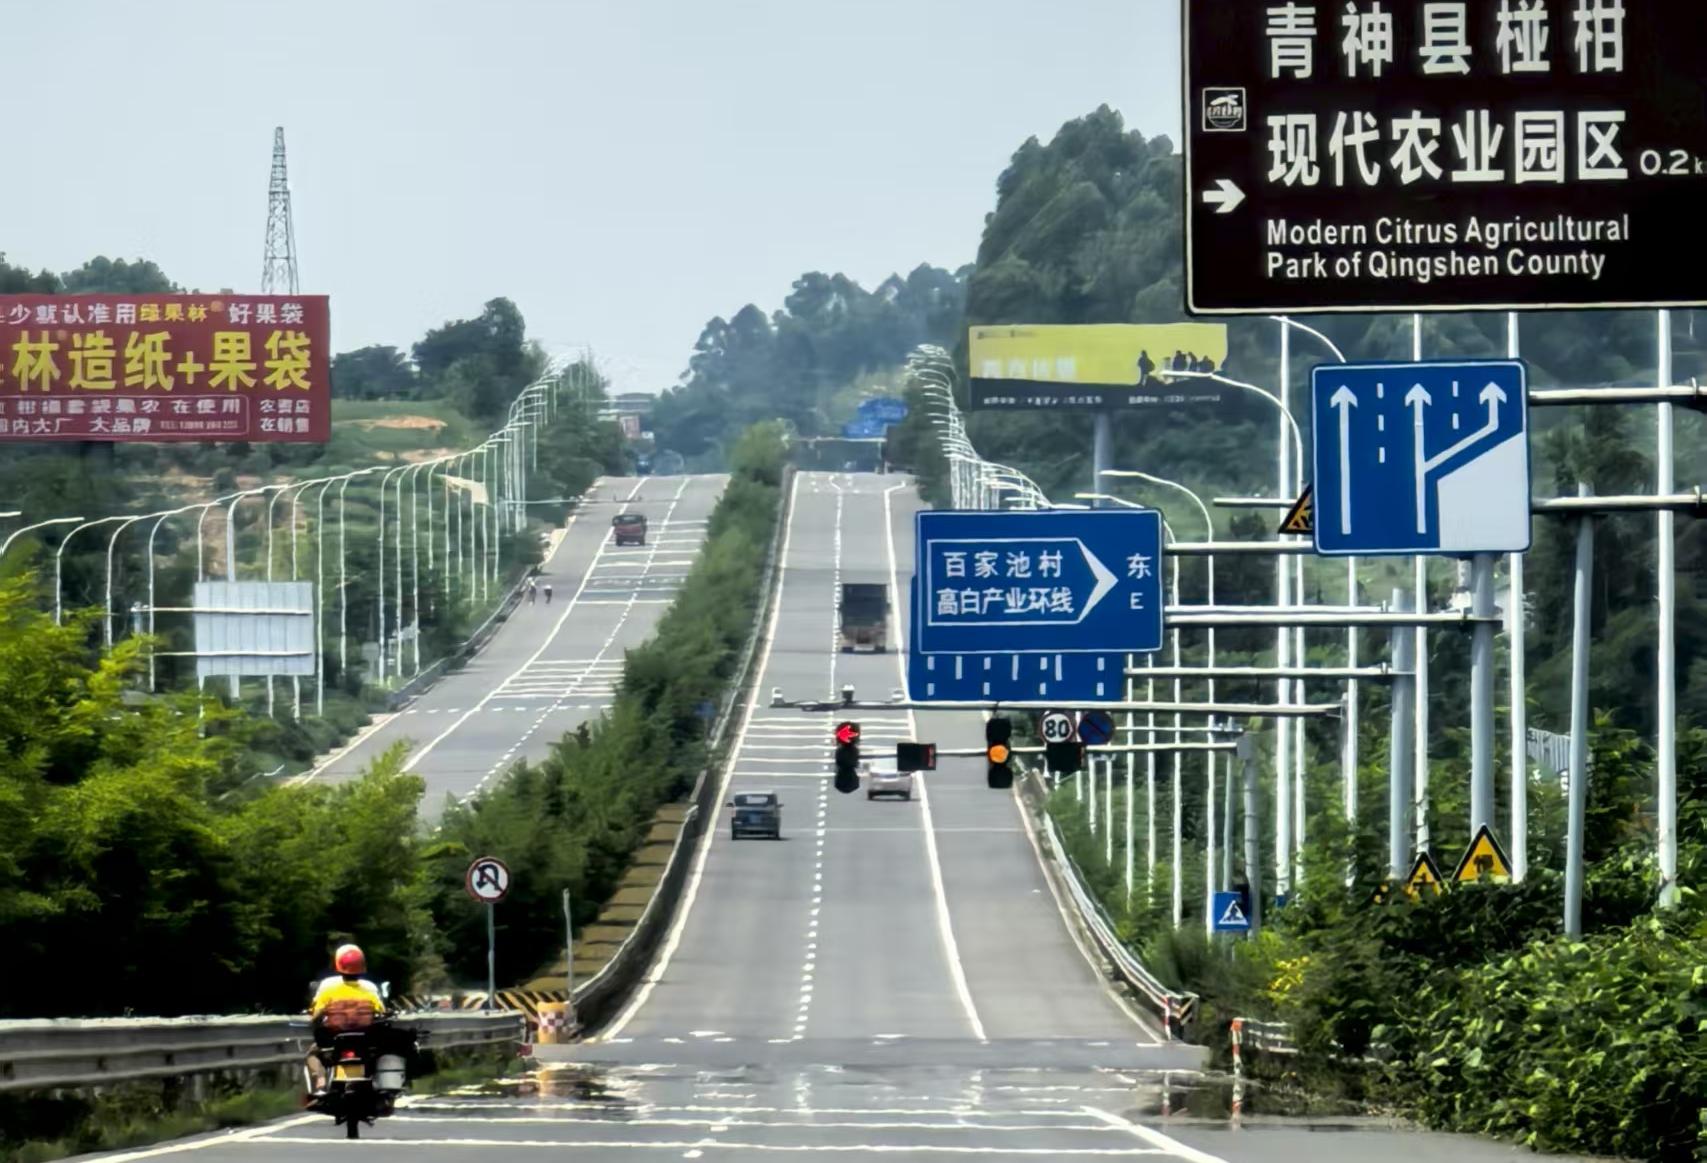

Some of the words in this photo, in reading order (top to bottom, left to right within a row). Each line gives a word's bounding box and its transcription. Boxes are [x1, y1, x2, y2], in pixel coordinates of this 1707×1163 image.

[1266, 1, 1625, 78] 青神县椪柑
[1267, 109, 1628, 187] 现代农业园区
[1640, 148, 1707, 176] 0.2k
[1267, 218, 1367, 246] Modern
[1375, 217, 1458, 244] Citrus
[1464, 214, 1629, 249] Agricultural
[1267, 251, 1328, 278] Park
[1334, 251, 1362, 278] of
[1368, 249, 1499, 284] Qingshen
[1506, 248, 1606, 280] County
[0, 329, 312, 391] 林造纸+果袋
[943, 550, 1063, 578] 百家池村
[1126, 553, 1152, 579] 东
[937, 587, 1074, 615] 高白产业环线
[1130, 592, 1144, 609] E
[1045, 719, 1069, 738] 80
